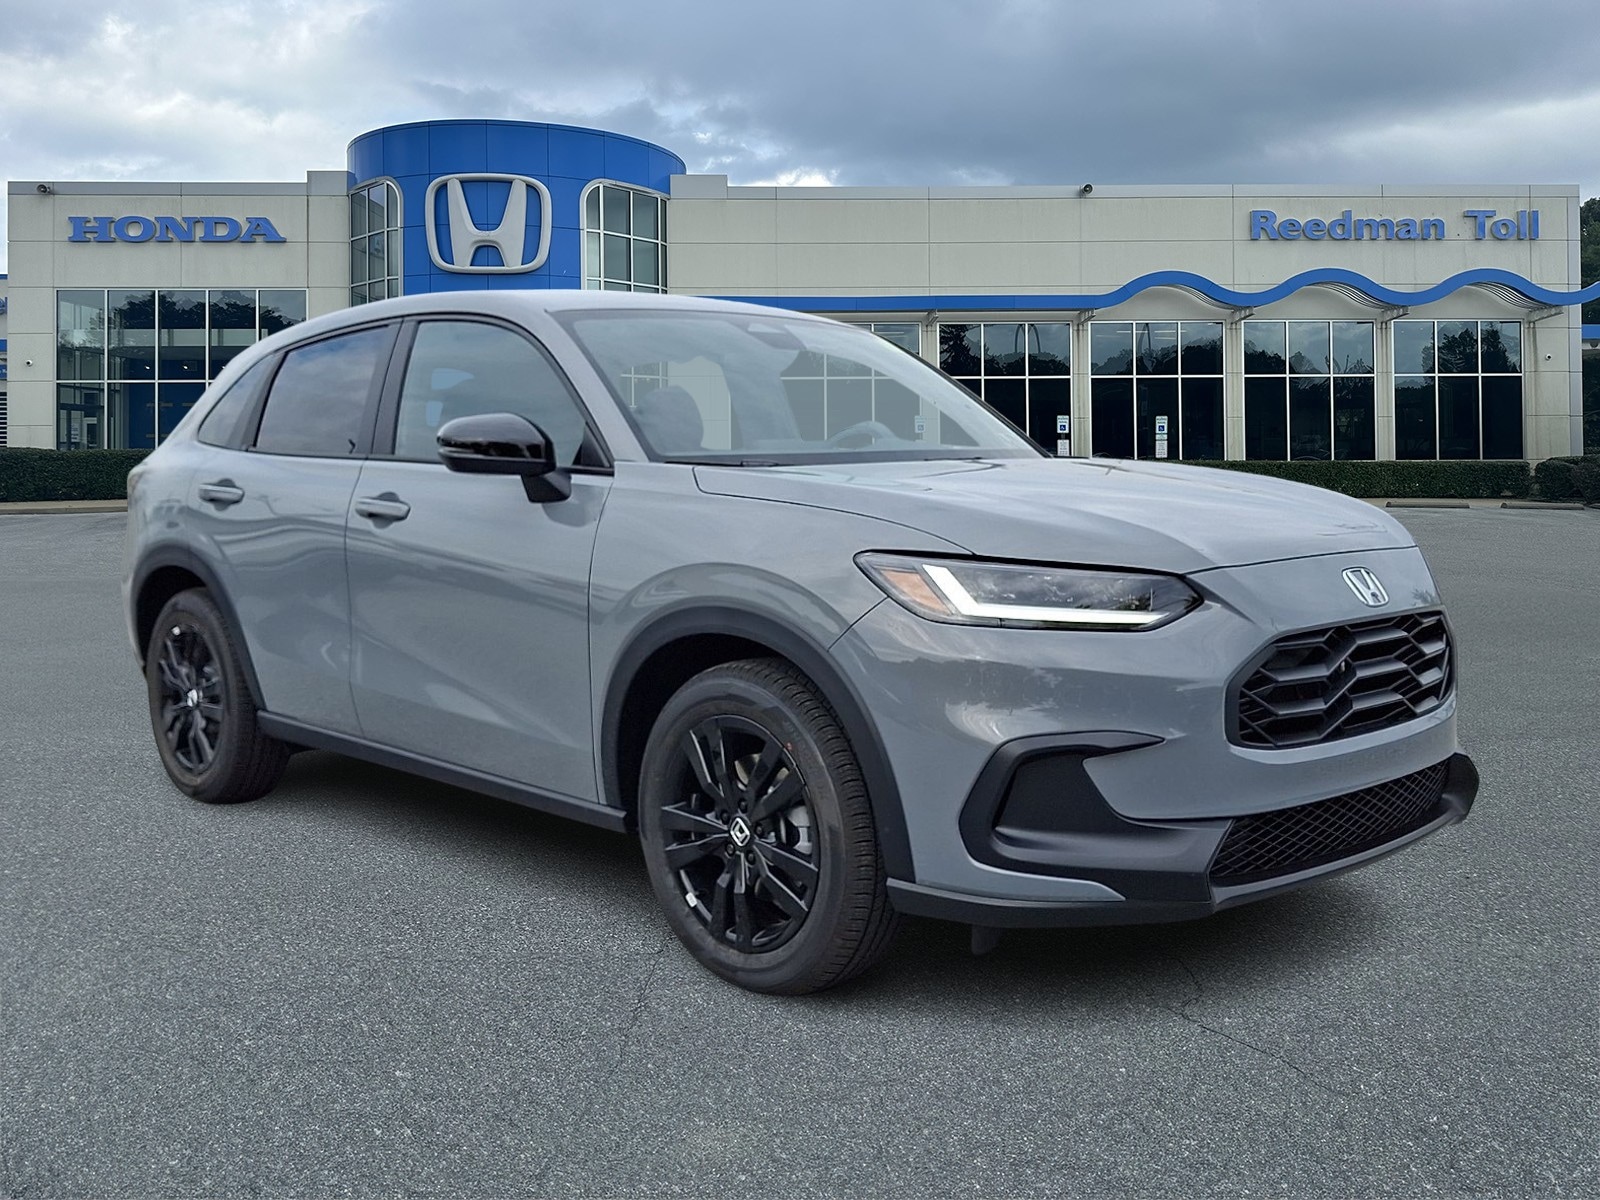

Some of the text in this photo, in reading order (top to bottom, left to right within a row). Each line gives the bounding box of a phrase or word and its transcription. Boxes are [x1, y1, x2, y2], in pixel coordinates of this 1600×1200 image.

[68, 216, 287, 243] HONDA
[1250, 209, 1540, 240] Reedman Toll
